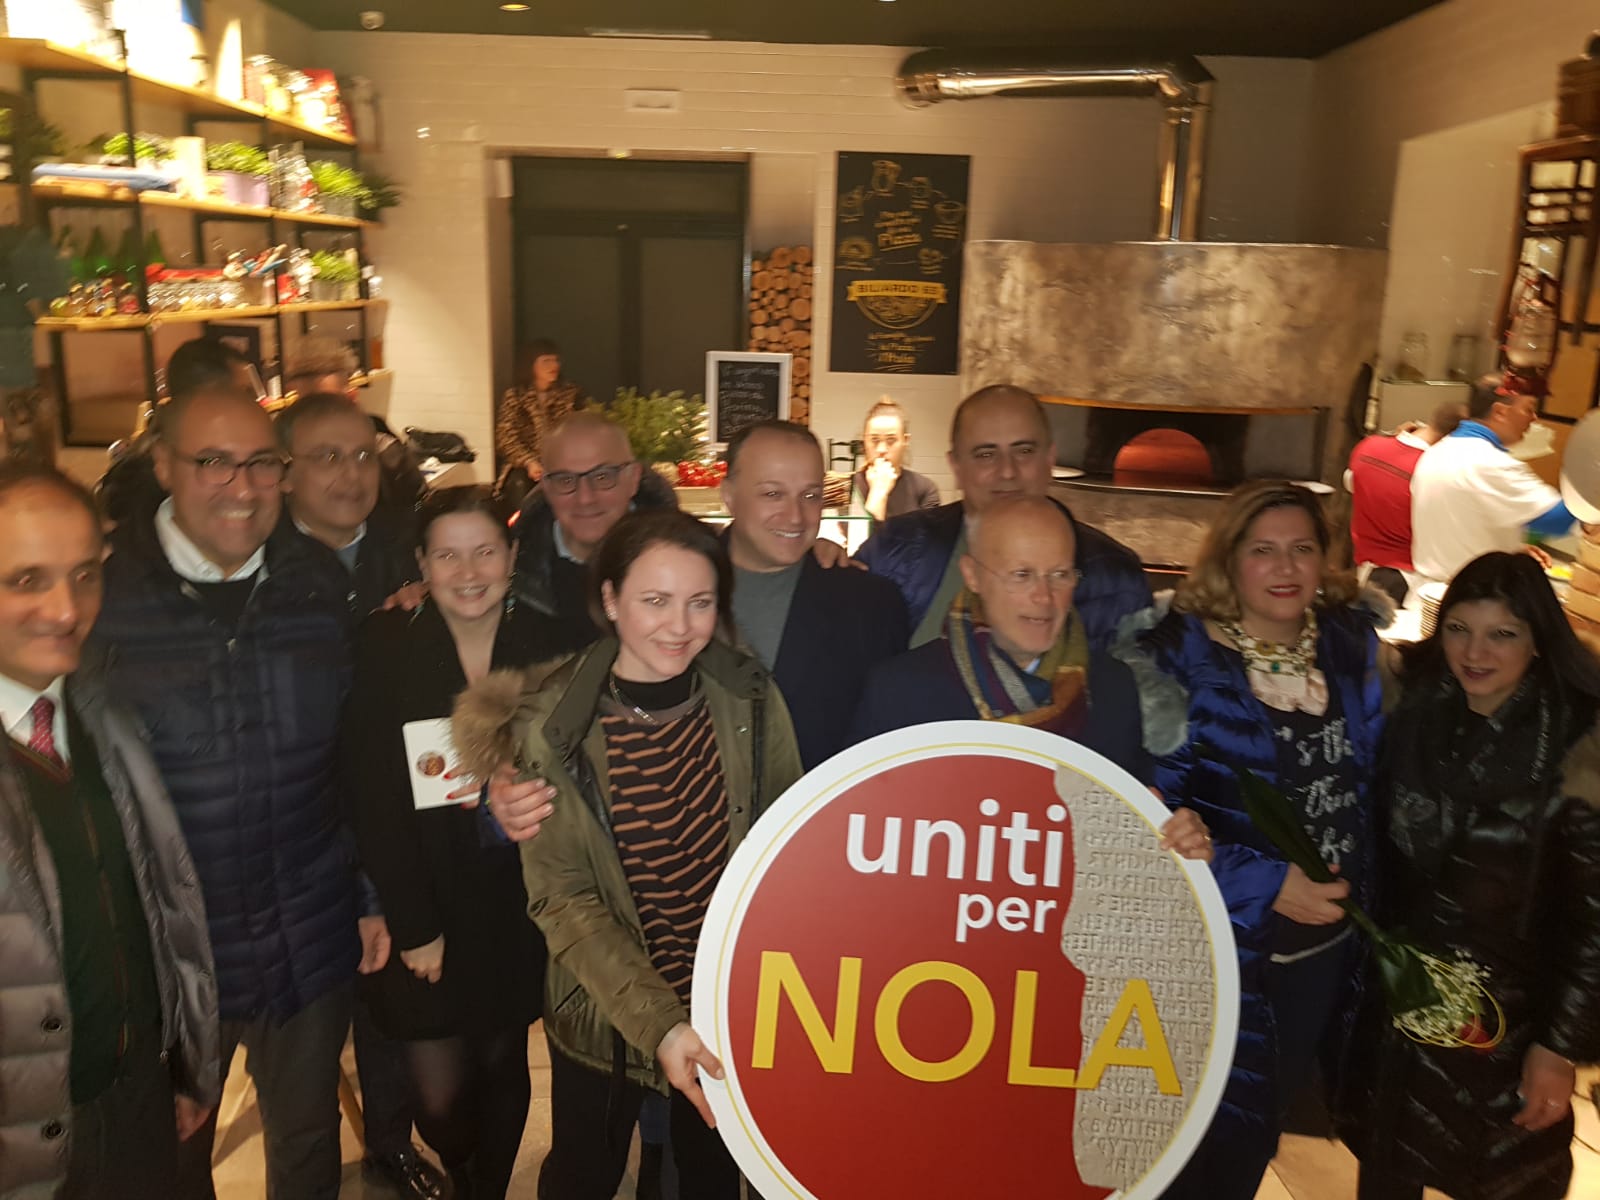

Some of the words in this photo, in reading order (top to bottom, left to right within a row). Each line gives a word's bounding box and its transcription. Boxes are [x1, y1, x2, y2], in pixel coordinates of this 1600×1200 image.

[845, 798, 1067, 888] uniti
[955, 891, 1057, 943] per
[751, 949, 1183, 1097] NOLA
